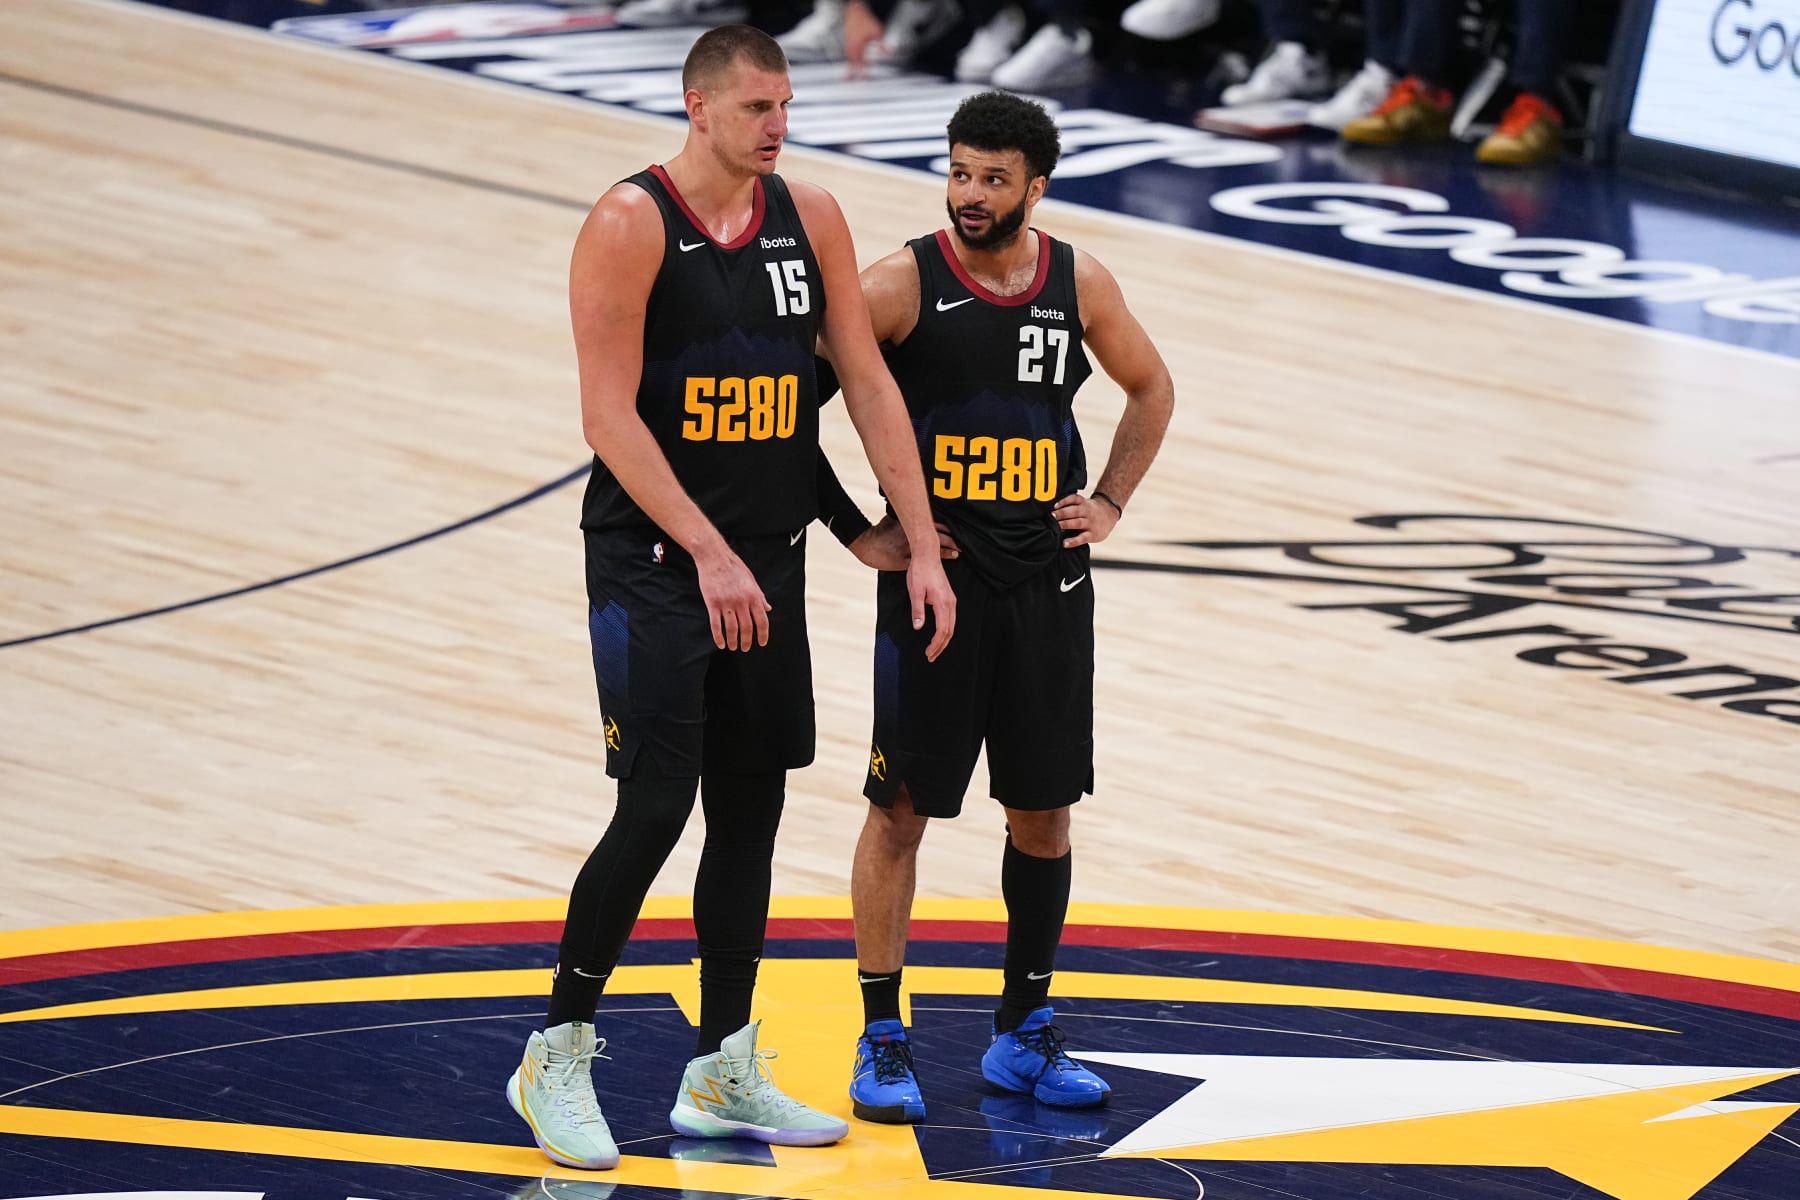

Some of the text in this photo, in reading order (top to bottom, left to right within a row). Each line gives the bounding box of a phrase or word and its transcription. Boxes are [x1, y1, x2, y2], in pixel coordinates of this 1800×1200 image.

[760, 237, 796, 249] ibotta
[765, 259, 811, 317] 15
[1030, 306, 1065, 321] ibotta
[1017, 324, 1070, 385] 27
[682, 374, 799, 441] 5280
[933, 434, 1058, 502] 5280
